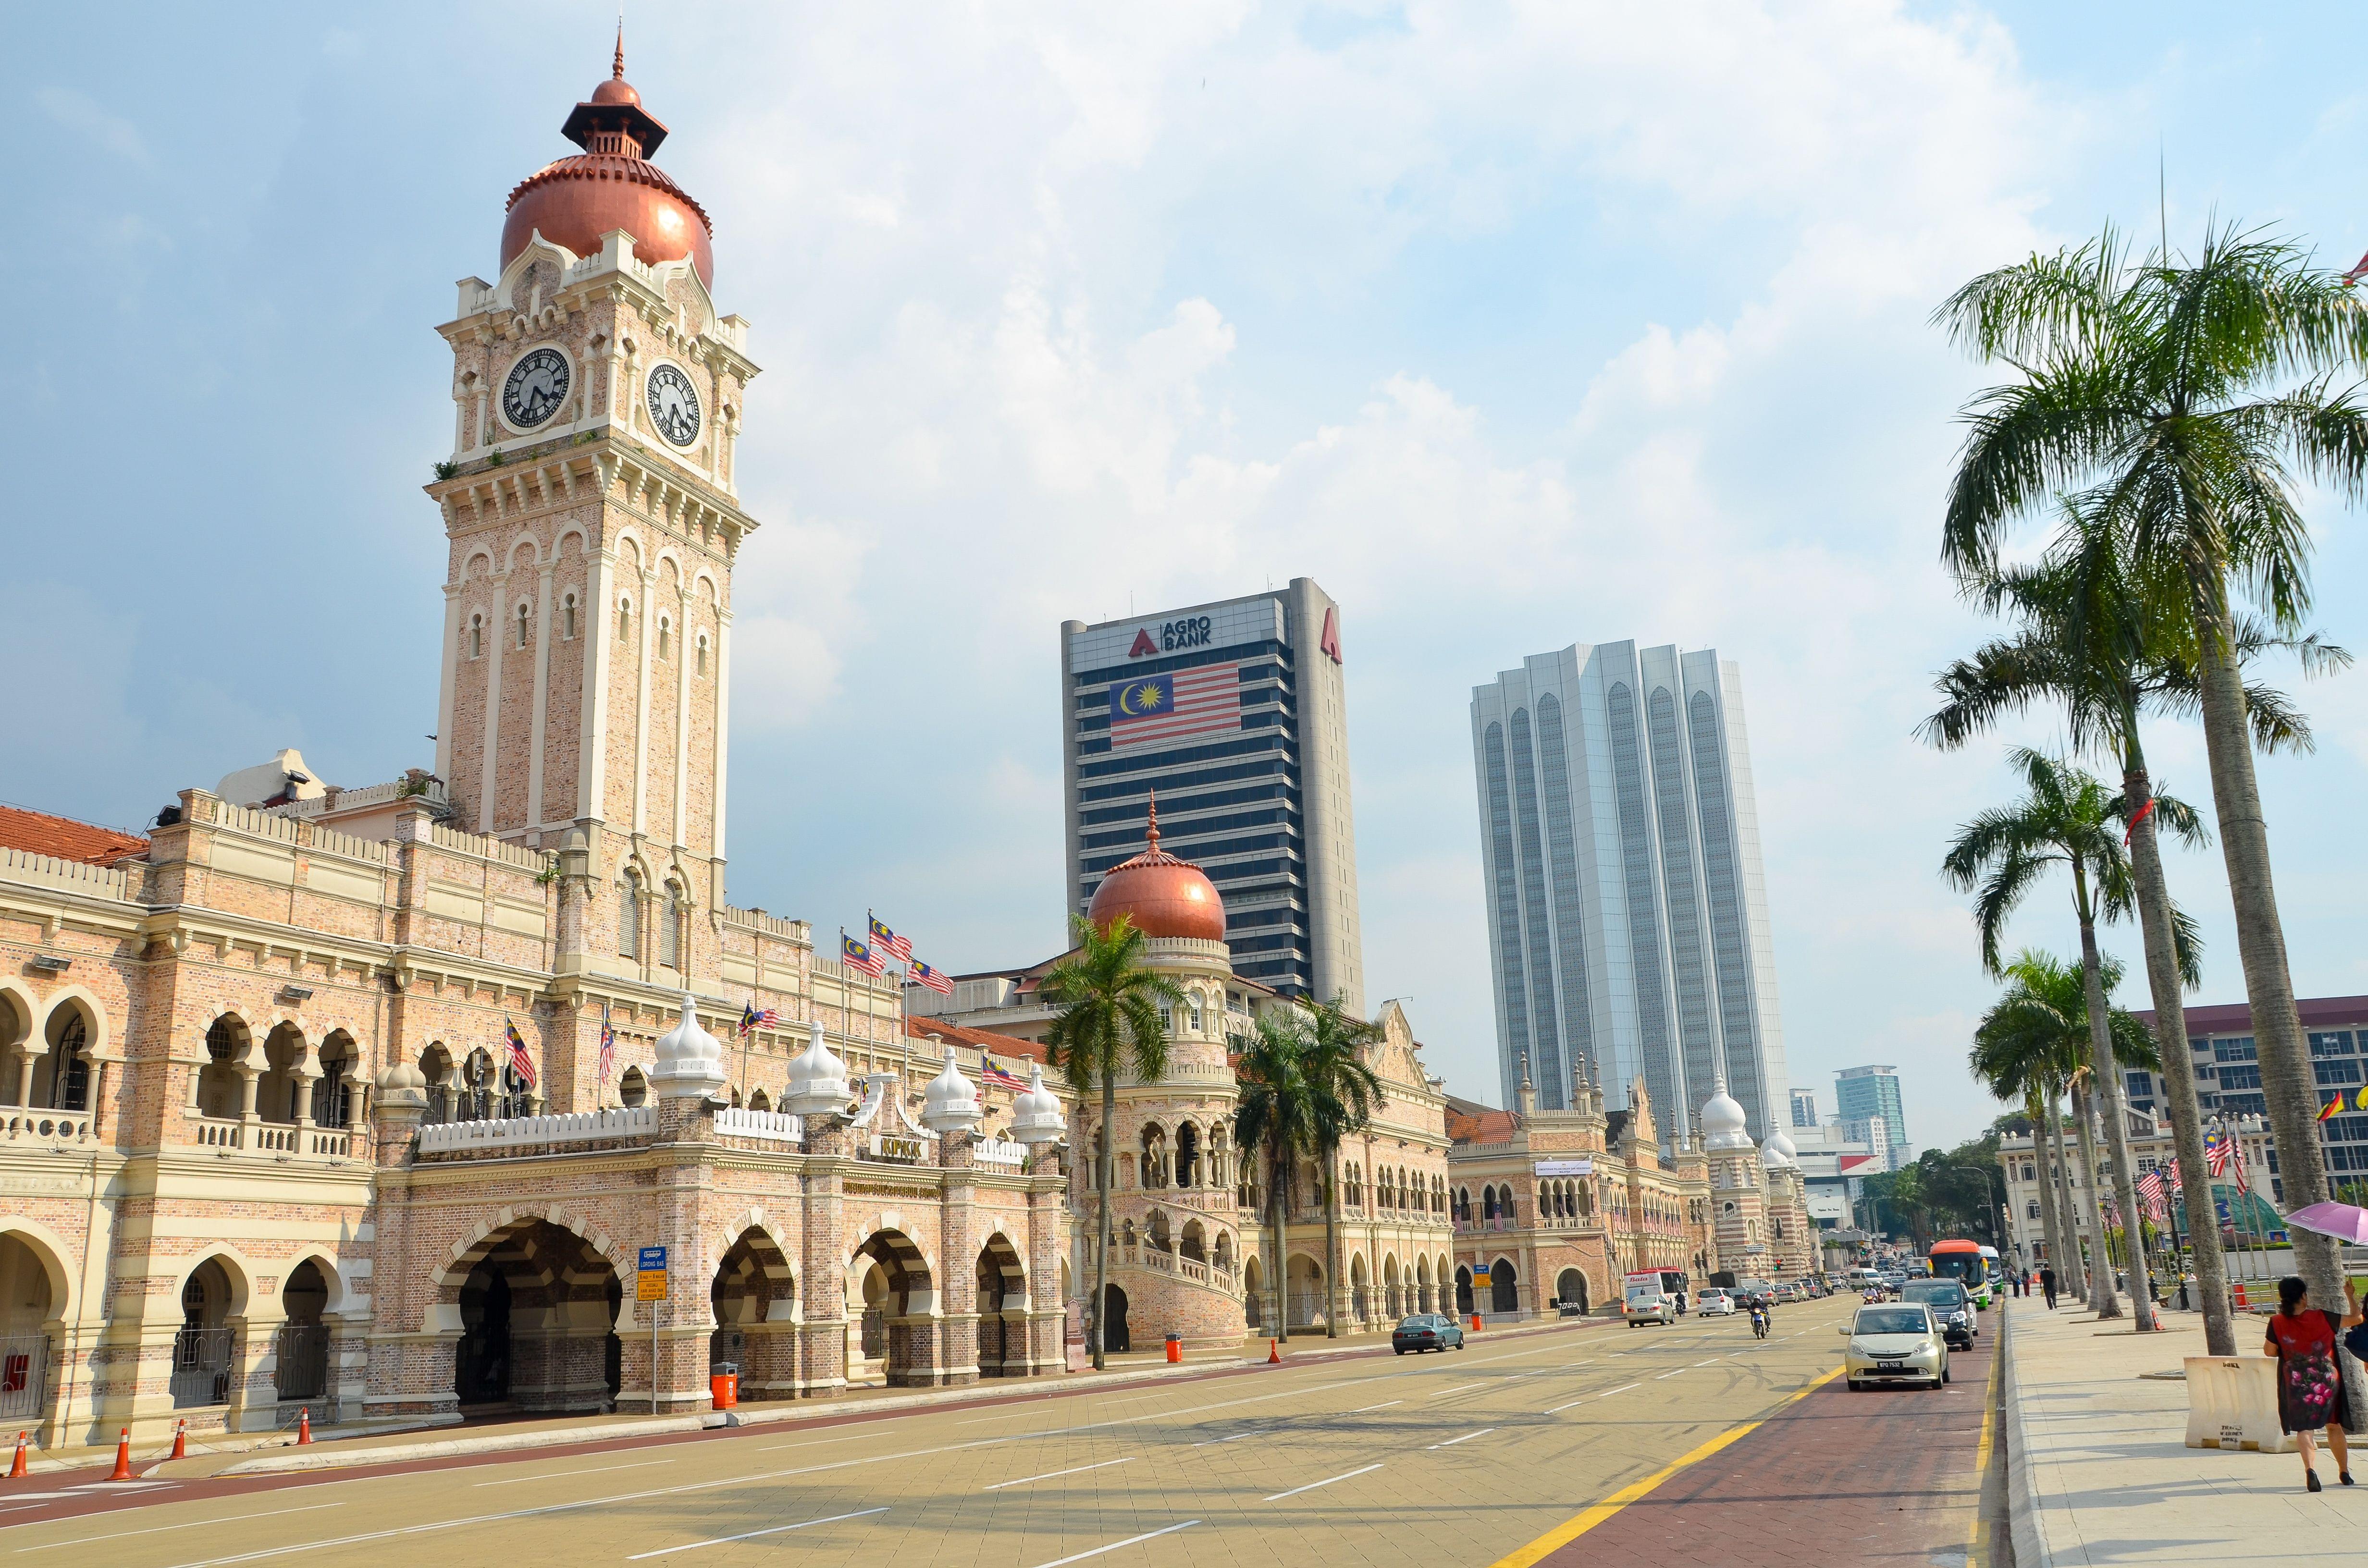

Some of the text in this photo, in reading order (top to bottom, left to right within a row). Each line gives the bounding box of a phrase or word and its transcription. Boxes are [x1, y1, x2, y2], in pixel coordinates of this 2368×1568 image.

[1163, 616, 1211, 637] AGRO
[1164, 630, 1211, 651] BANK
[881, 1137, 922, 1158] KPKK
[900, 1186, 918, 1197] ABDUL
[920, 1187, 942, 1199] SAMAD
